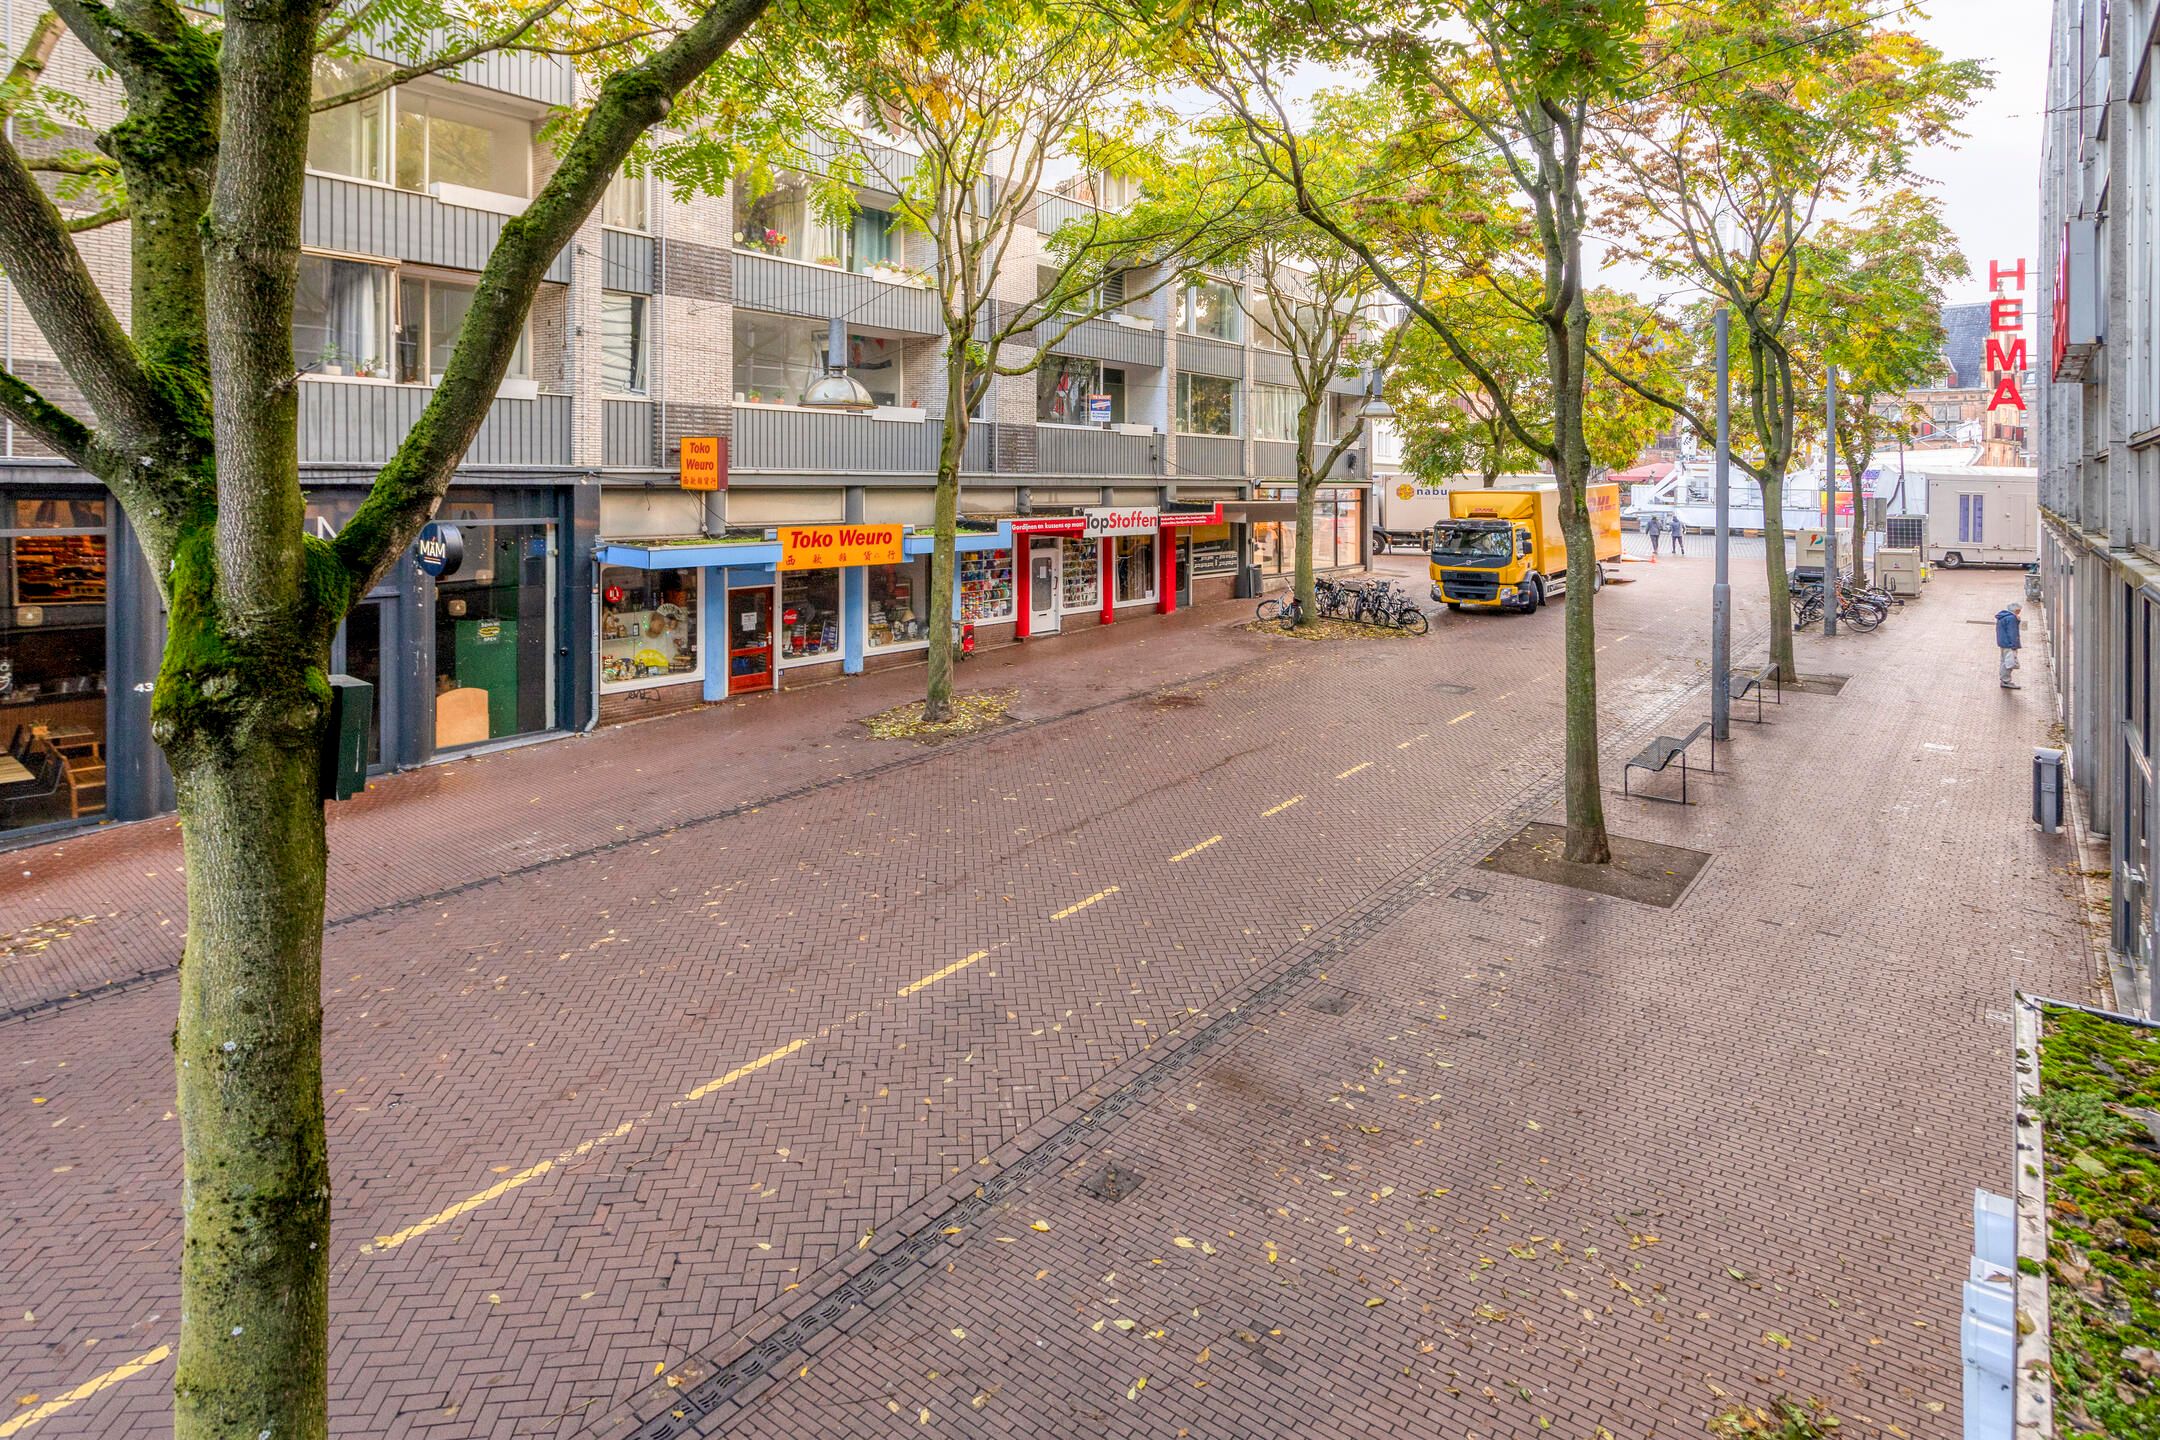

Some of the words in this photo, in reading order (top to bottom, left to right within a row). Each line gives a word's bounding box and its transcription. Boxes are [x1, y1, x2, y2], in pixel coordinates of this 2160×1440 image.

[1986, 258, 2027, 411] HEMA
[690, 442, 710, 454] Toko
[686, 458, 714, 470] Weuro
[1416, 488, 1456, 496] nabu
[1085, 510, 1157, 534] TopStoffen
[791, 531, 833, 549] Toko
[839, 529, 893, 547] Weuro
